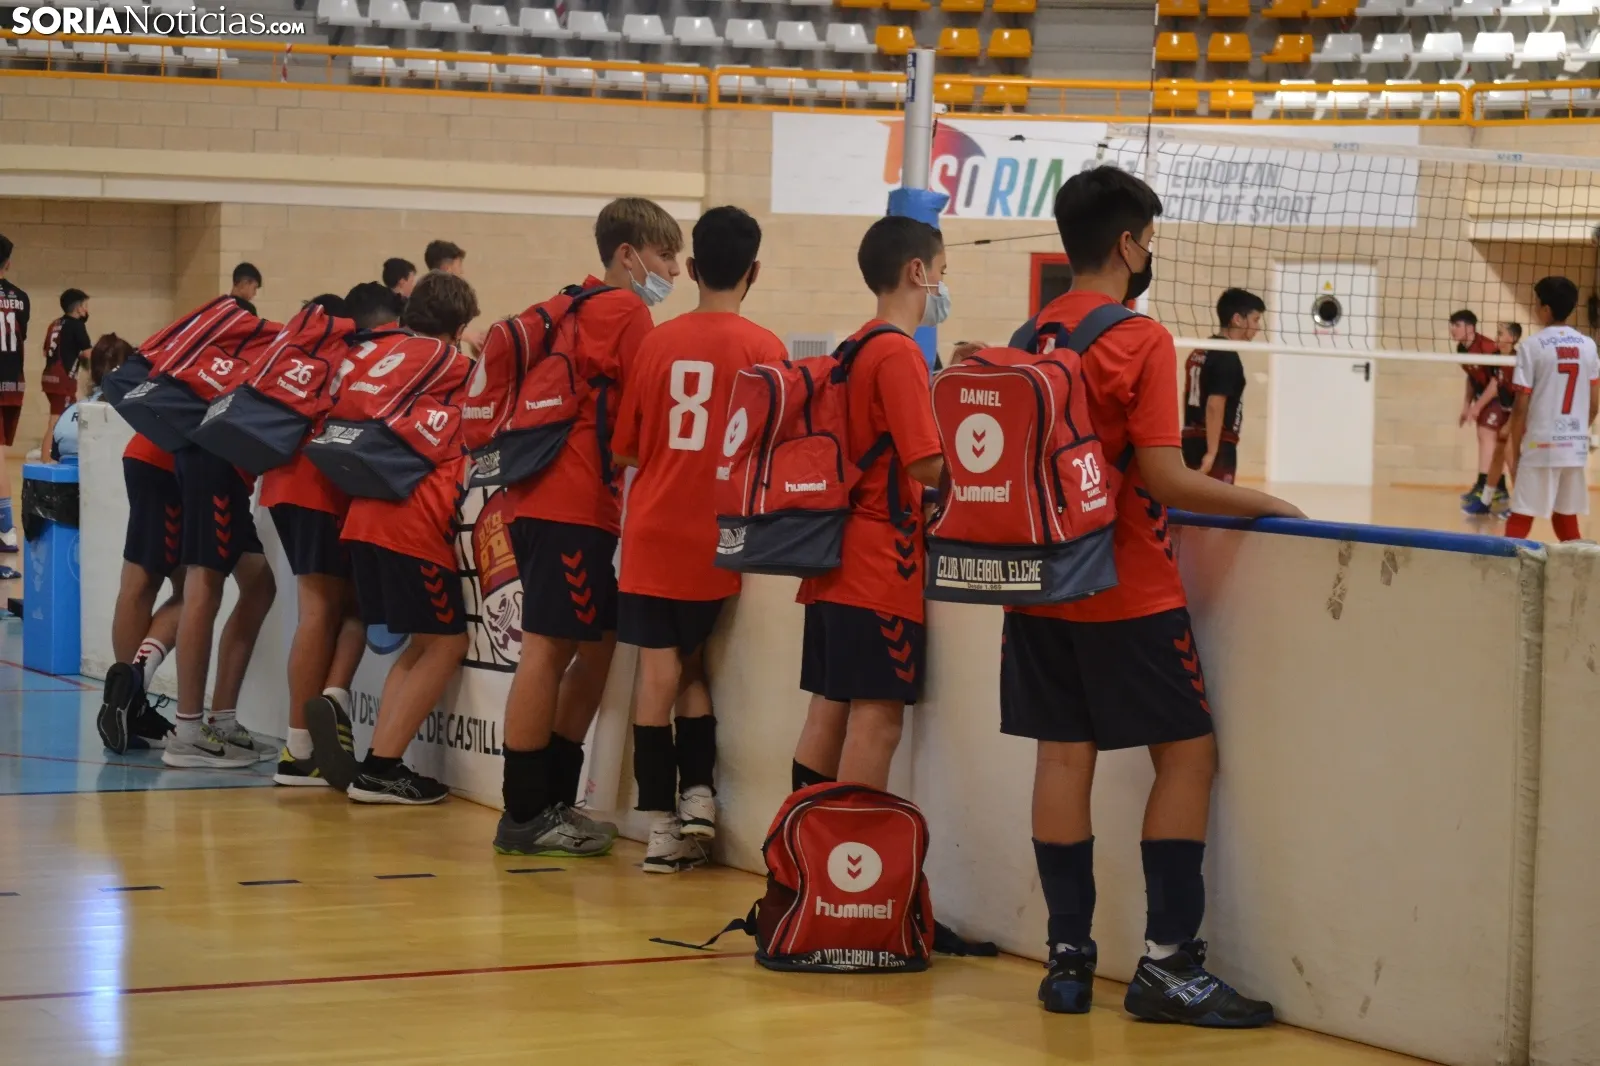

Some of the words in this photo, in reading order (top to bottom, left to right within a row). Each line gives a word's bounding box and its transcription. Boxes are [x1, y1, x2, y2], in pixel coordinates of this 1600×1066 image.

[930, 153, 1064, 217] SORIA
[1171, 160, 1280, 190] EUROPEAN
[1163, 193, 1213, 221] CITY
[1217, 195, 1246, 222] OF
[1249, 196, 1317, 224] SPORT
[210, 357, 234, 376] 19
[284, 358, 315, 385] 26
[960, 387, 1002, 407] DANIEL
[1557, 363, 1579, 415] 7
[525, 395, 563, 411] hummel
[669, 360, 714, 451] 8
[426, 409, 449, 432] 10
[1072, 452, 1100, 491] 20
[785, 480, 827, 492] hummel
[951, 479, 1011, 504] hummel
[1081, 493, 1108, 512] hummel
[937, 555, 959, 579] CLUB
[959, 558, 1006, 582] VOLEIBOL
[1007, 559, 1043, 582] ELCHE
[427, 711, 444, 745] DE
[815, 896, 895, 920] hummel
